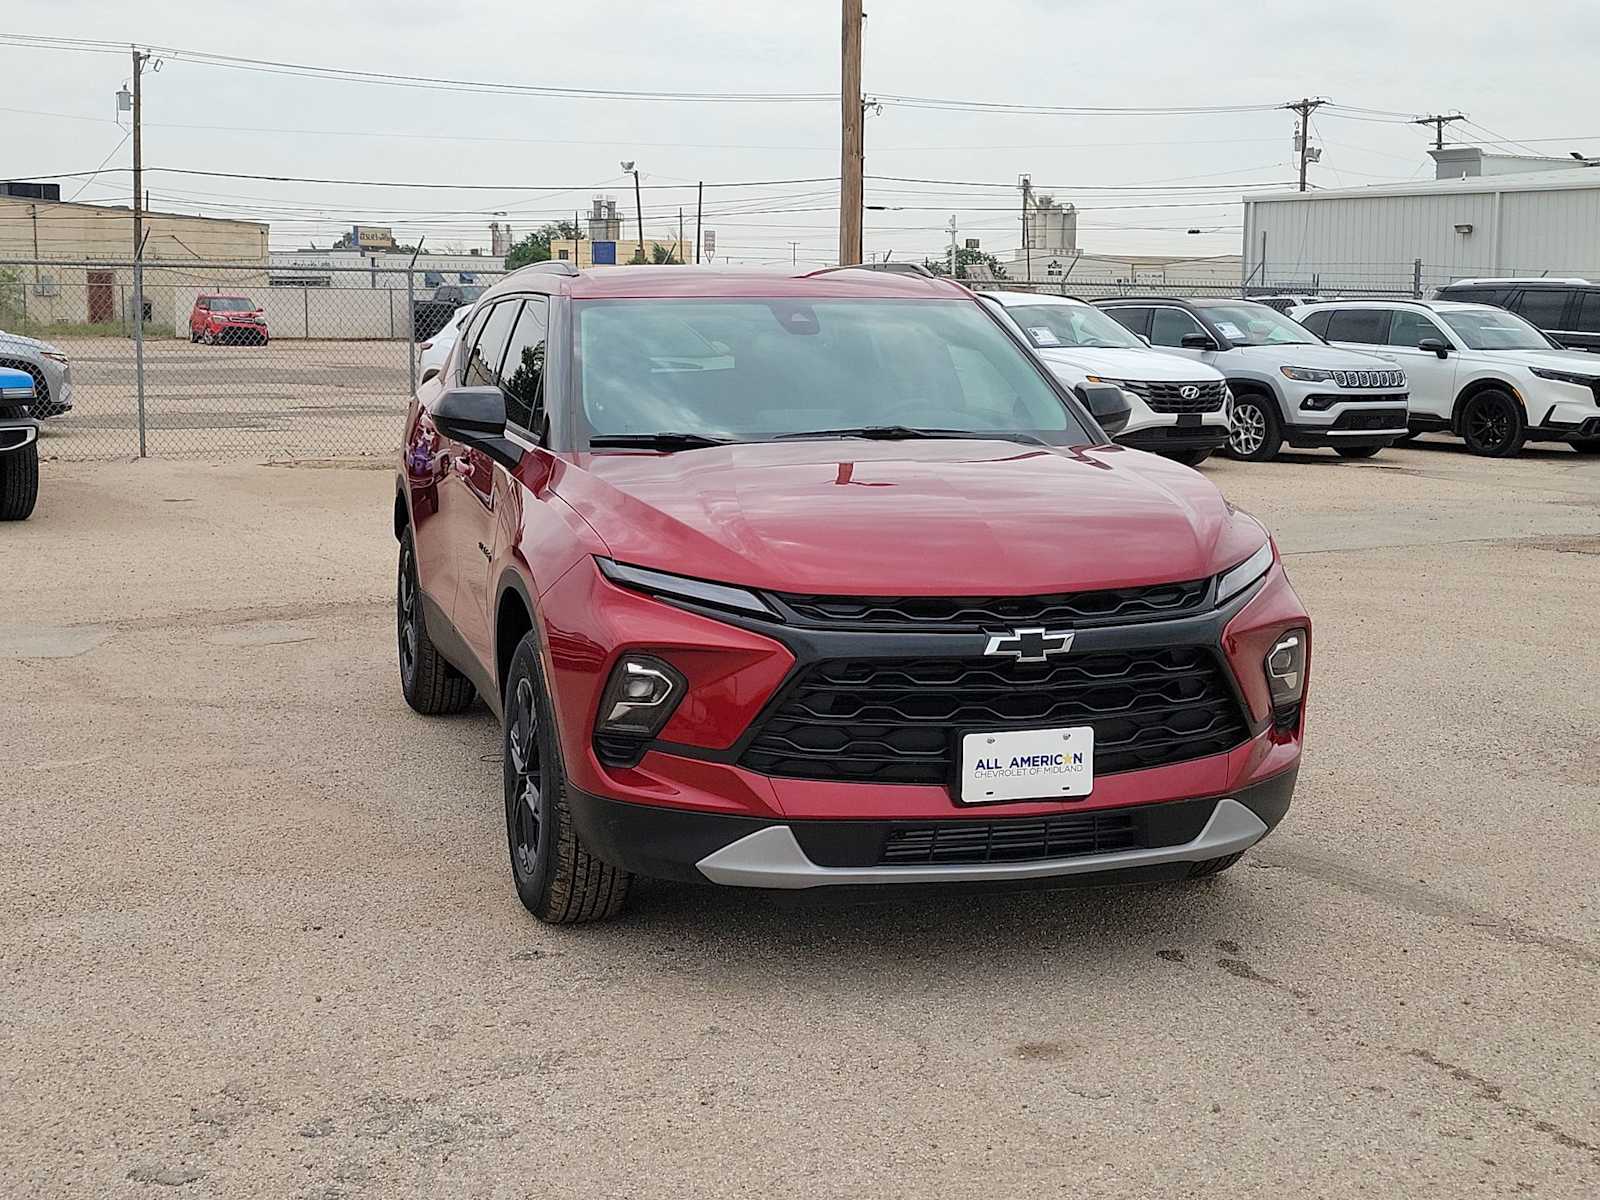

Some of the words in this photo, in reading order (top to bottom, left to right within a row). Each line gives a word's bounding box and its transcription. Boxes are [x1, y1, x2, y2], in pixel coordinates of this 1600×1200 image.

[975, 758, 1002, 770] ALL
[975, 768, 1027, 778] CHEVROLET
[1029, 767, 1041, 775] OF
[1044, 765, 1083, 774] MIDLAND
